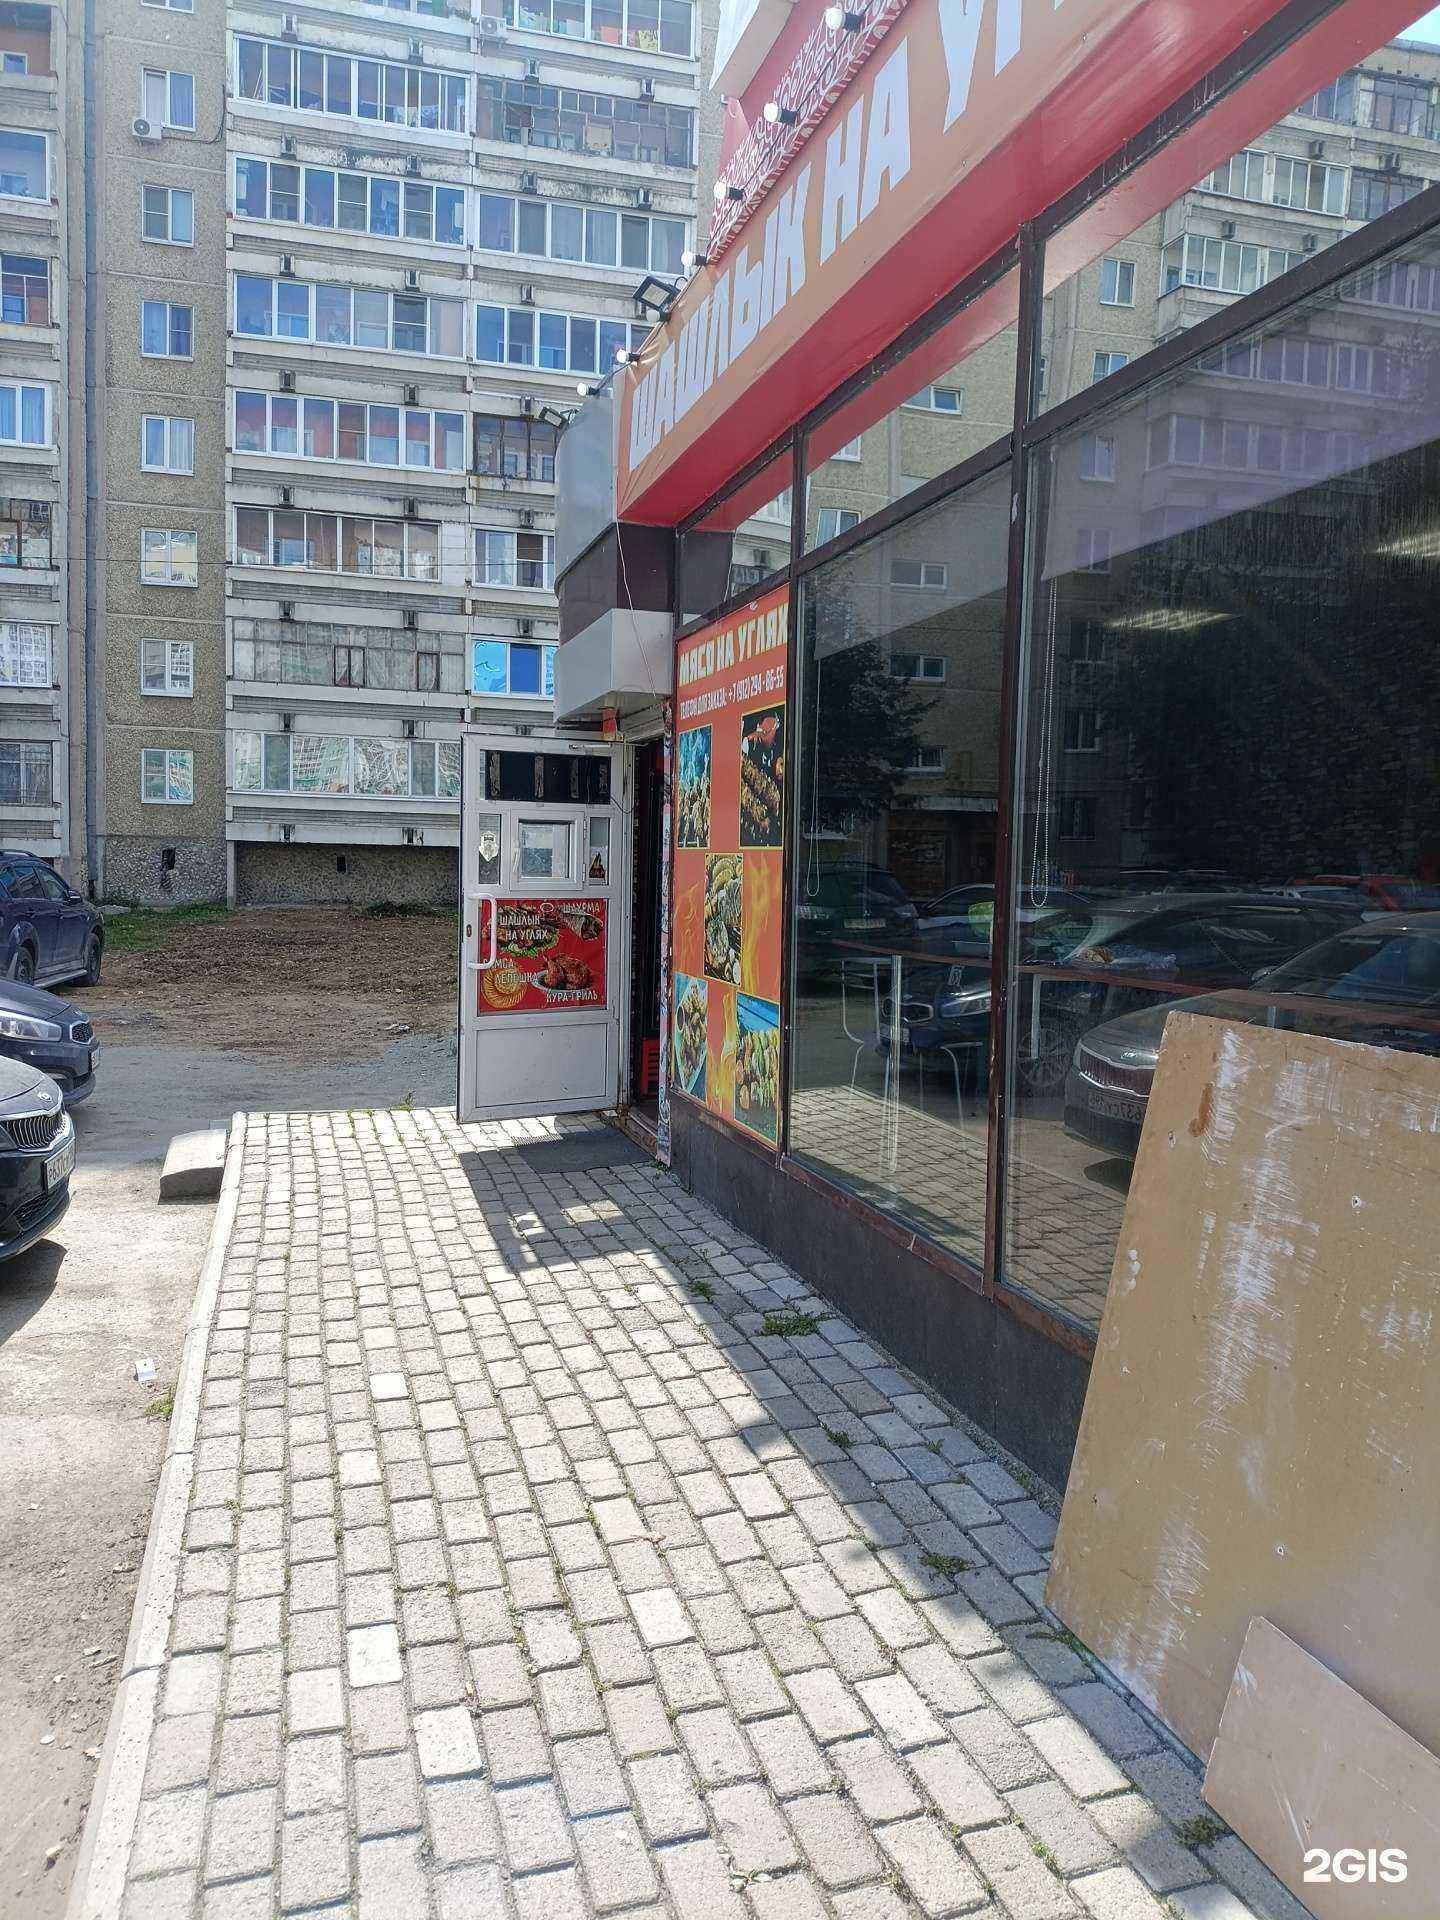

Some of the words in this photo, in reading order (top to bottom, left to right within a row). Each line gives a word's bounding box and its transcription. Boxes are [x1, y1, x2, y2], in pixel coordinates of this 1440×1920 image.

[629, 163, 811, 473] ШАШЛЫК
[820, 35, 911, 267] НА
[679, 640, 715, 687] МЯСО
[717, 630, 734, 672] НА
[737, 603, 788, 662] УГЛЯХ
[505, 930, 518, 941] НА
[520, 929, 548, 940] УГЛЯХ
